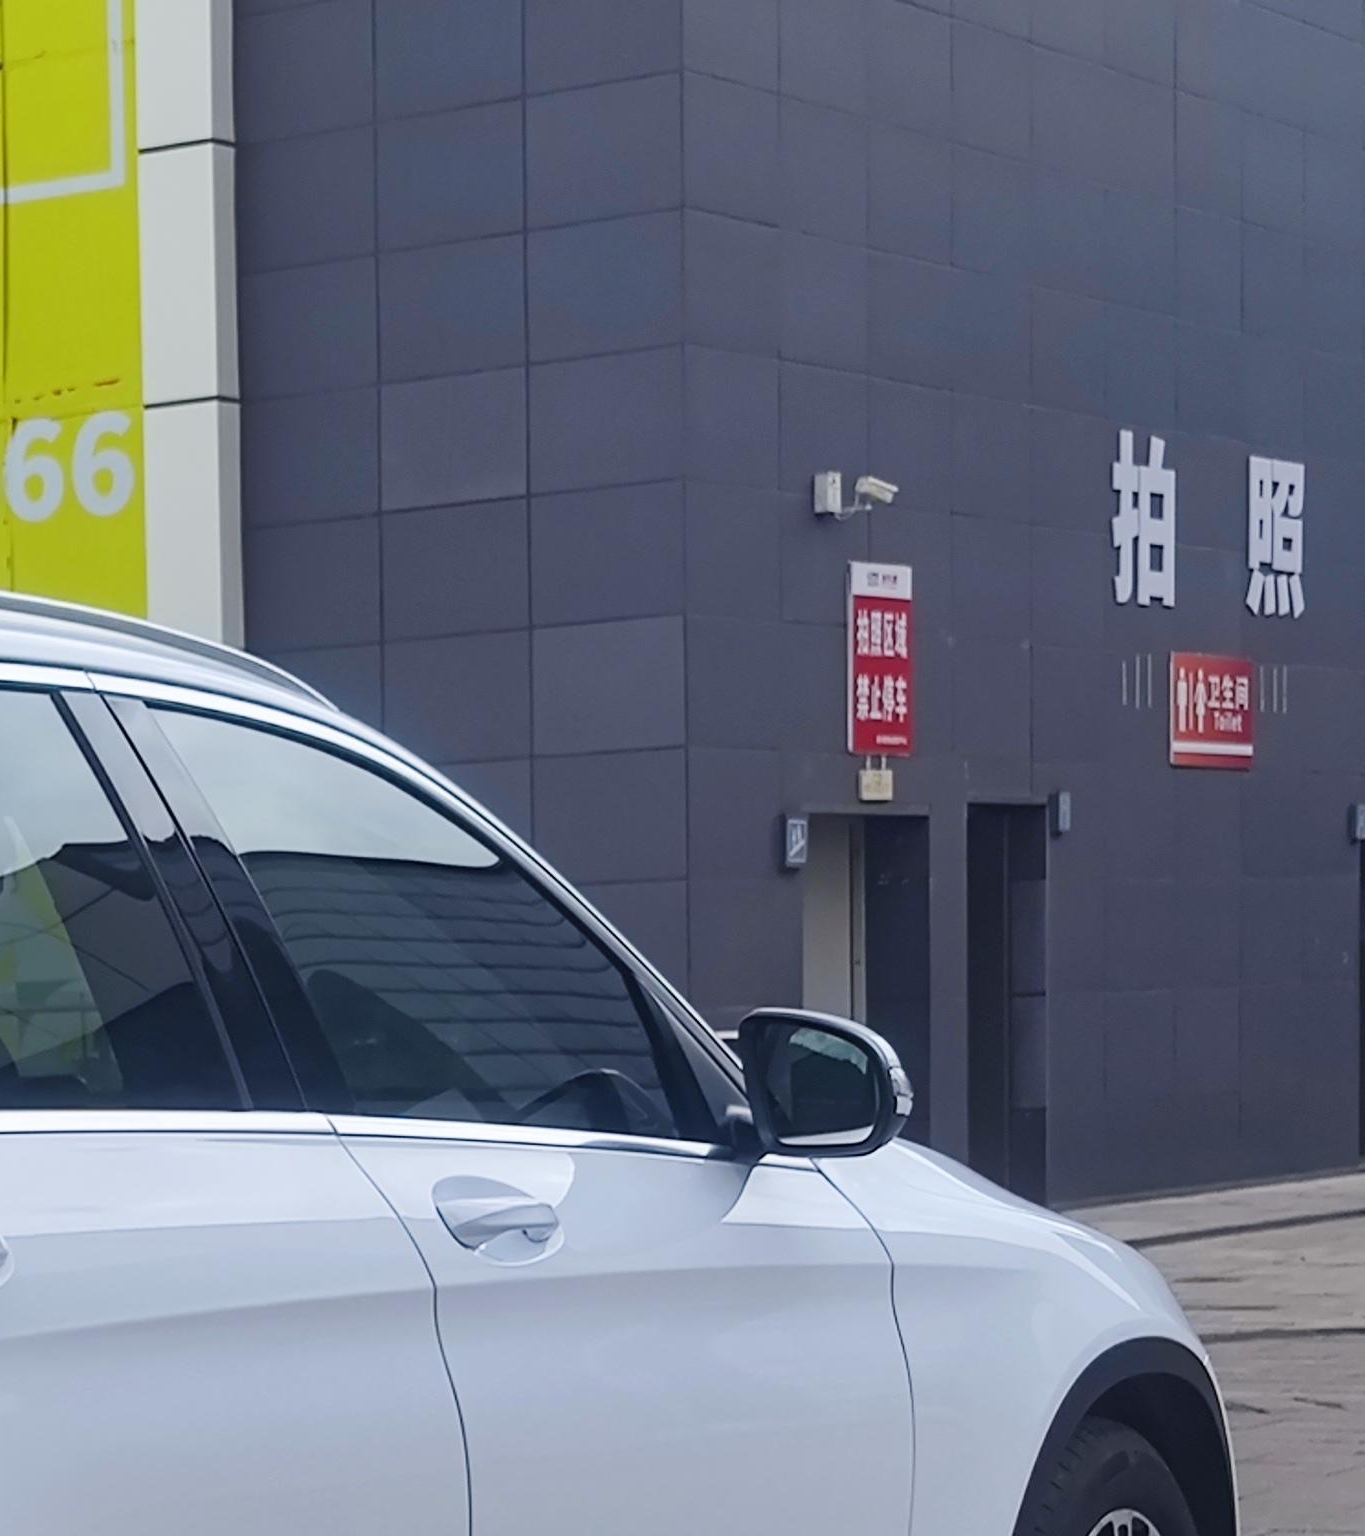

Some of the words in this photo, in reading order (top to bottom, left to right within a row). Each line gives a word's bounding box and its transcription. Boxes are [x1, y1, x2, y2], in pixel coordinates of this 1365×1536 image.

[1112, 428, 1305, 619] 拍照
[856, 673, 908, 723] 禁止停车
[1207, 674, 1249, 711] 卫生间
